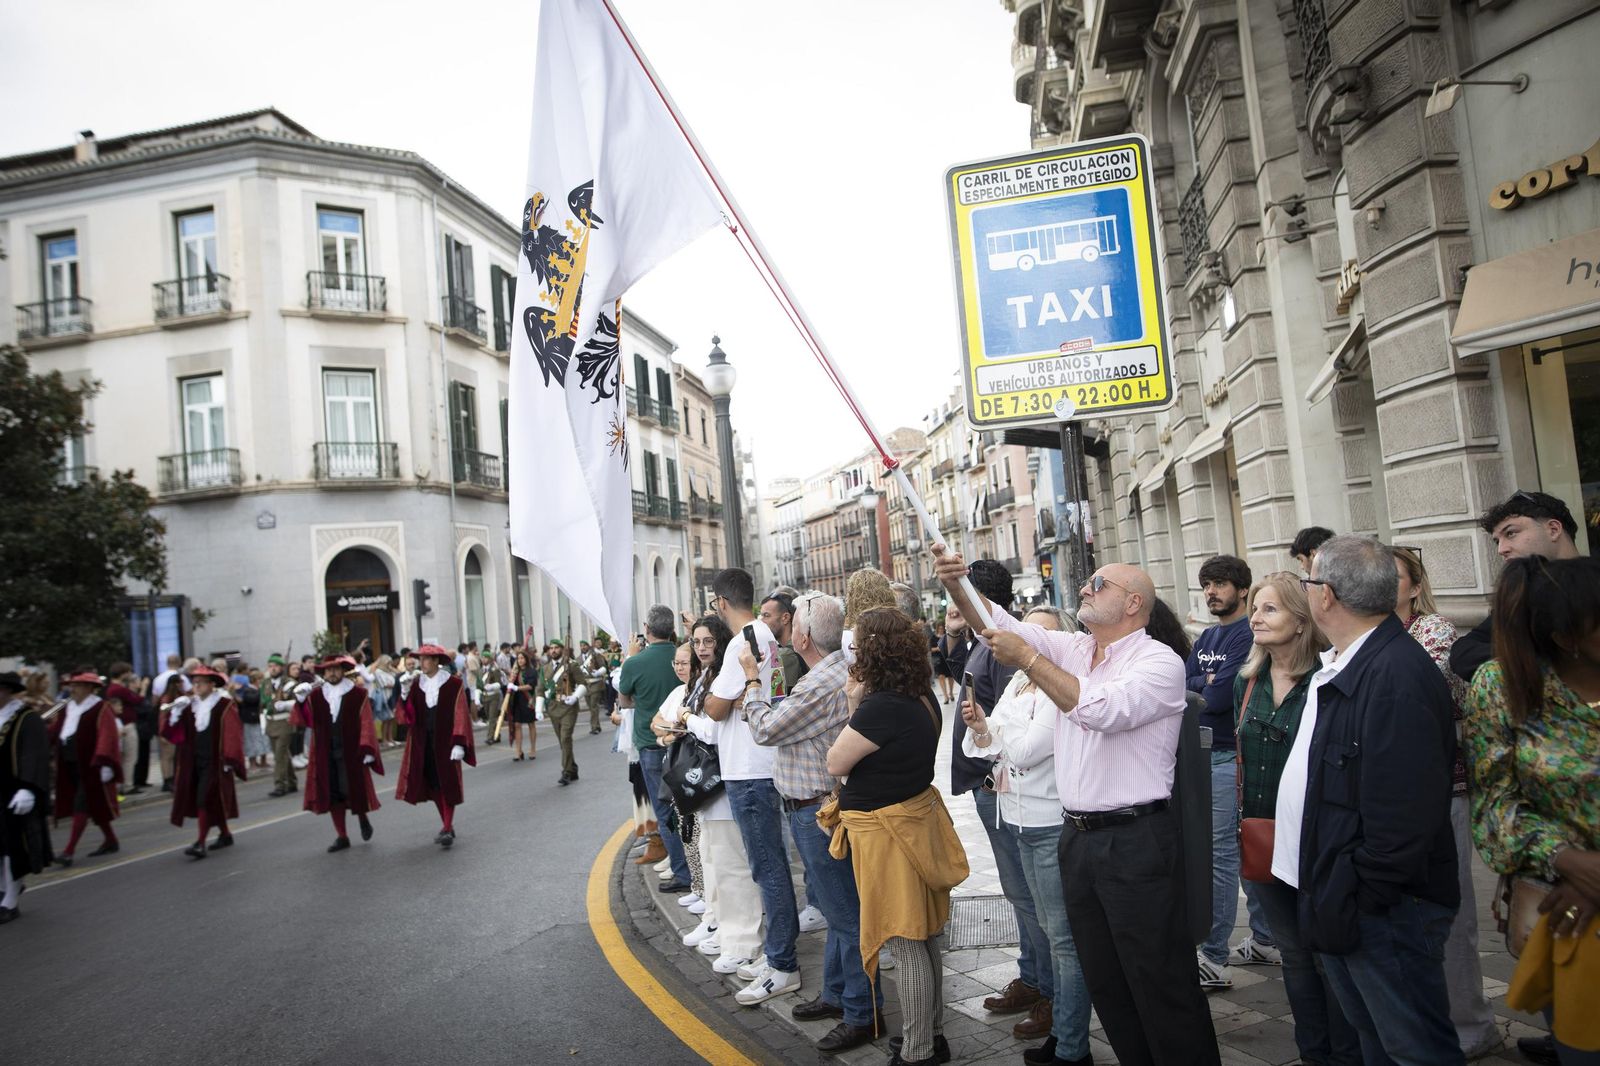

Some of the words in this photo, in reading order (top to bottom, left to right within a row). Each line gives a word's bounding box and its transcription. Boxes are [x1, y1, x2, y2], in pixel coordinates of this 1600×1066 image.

[964, 172, 1011, 188] CARRIL
[1015, 167, 1032, 180] DE
[1037, 152, 1131, 176] CIRCULACION
[965, 179, 1059, 203] ESPECIALMENTE
[1063, 167, 1131, 188] PROTEGIDO
[1007, 285, 1114, 329] TAXI
[989, 374, 1055, 393] VEHÍCULOS
[1059, 363, 1147, 385] AUTORIZADOS
[1028, 356, 1091, 375] URBANOS
[1095, 354, 1103, 366] Y
[981, 397, 1005, 417] DE
[1013, 393, 1052, 414] 7:30
[1077, 383, 1132, 406] 22:00
[348, 595, 388, 605] Santander
